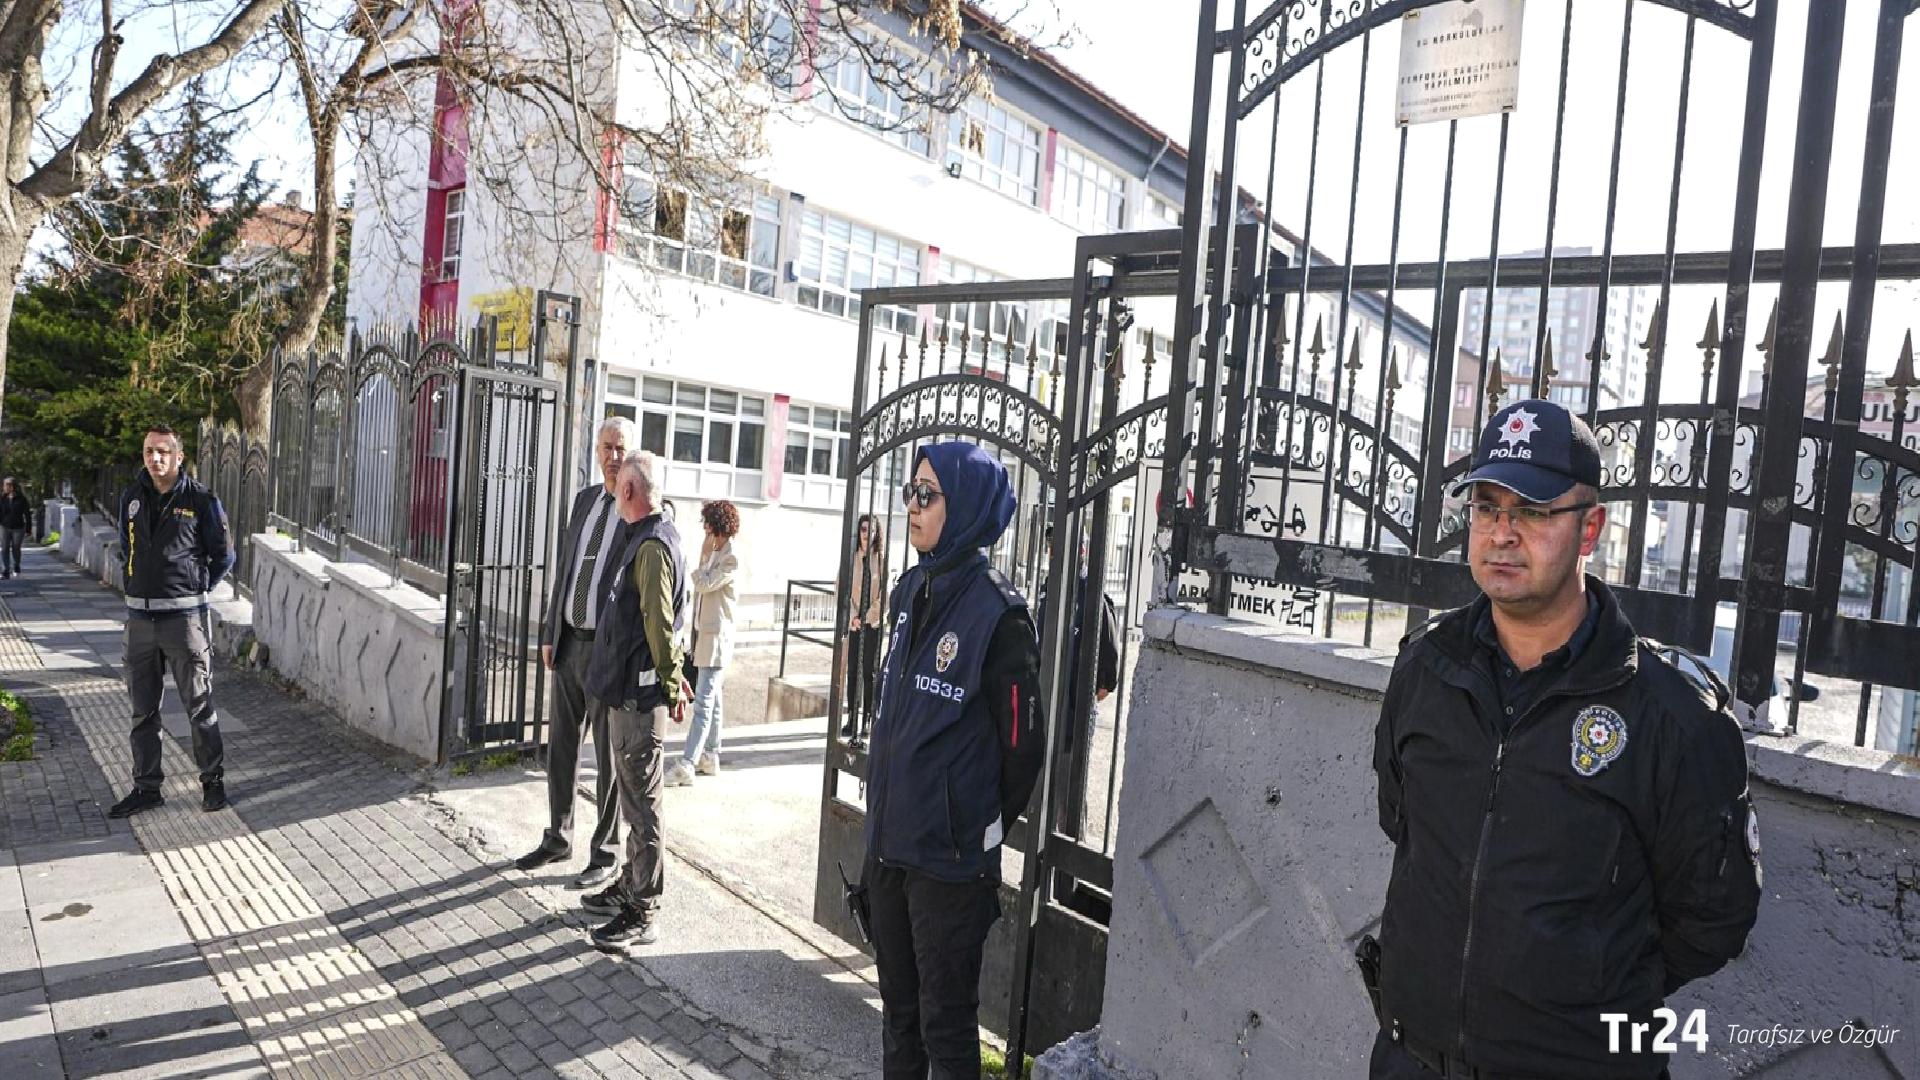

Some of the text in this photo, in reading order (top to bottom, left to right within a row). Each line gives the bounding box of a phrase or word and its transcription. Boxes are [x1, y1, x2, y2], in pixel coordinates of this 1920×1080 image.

[1489, 447, 1532, 459] POLİS
[1229, 591, 1275, 616] TMEK
[914, 674, 965, 703] 10532
